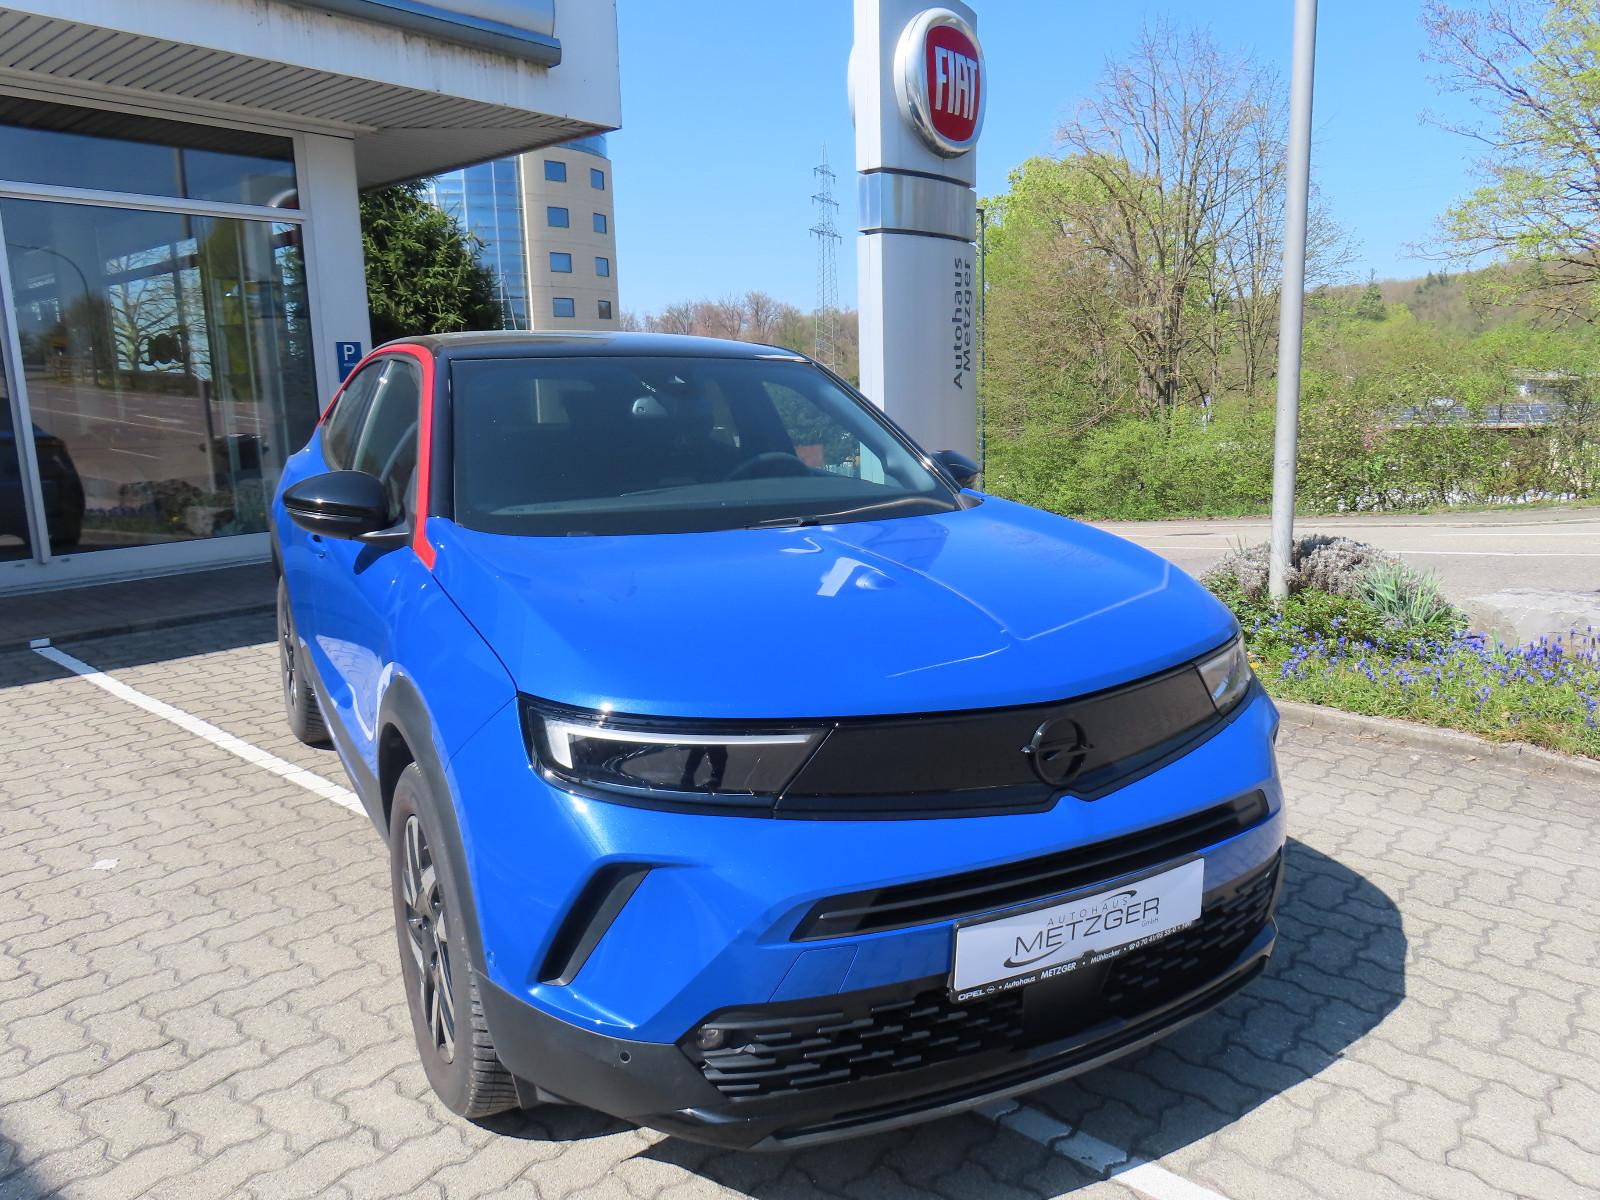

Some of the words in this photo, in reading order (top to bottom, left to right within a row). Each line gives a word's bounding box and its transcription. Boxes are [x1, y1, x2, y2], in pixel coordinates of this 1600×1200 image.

[935, 46, 977, 121] FIAT
[952, 257, 963, 390] Autohaus
[962, 259, 973, 372] Metzger
[343, 344, 356, 361] P
[1015, 897, 1160, 956] METZGER
[1047, 896, 1128, 926] AUTOHAUS
[957, 988, 986, 1001] OPEL
[1003, 975, 1036, 991] Autohaus
[1040, 961, 1077, 980] METZGER
